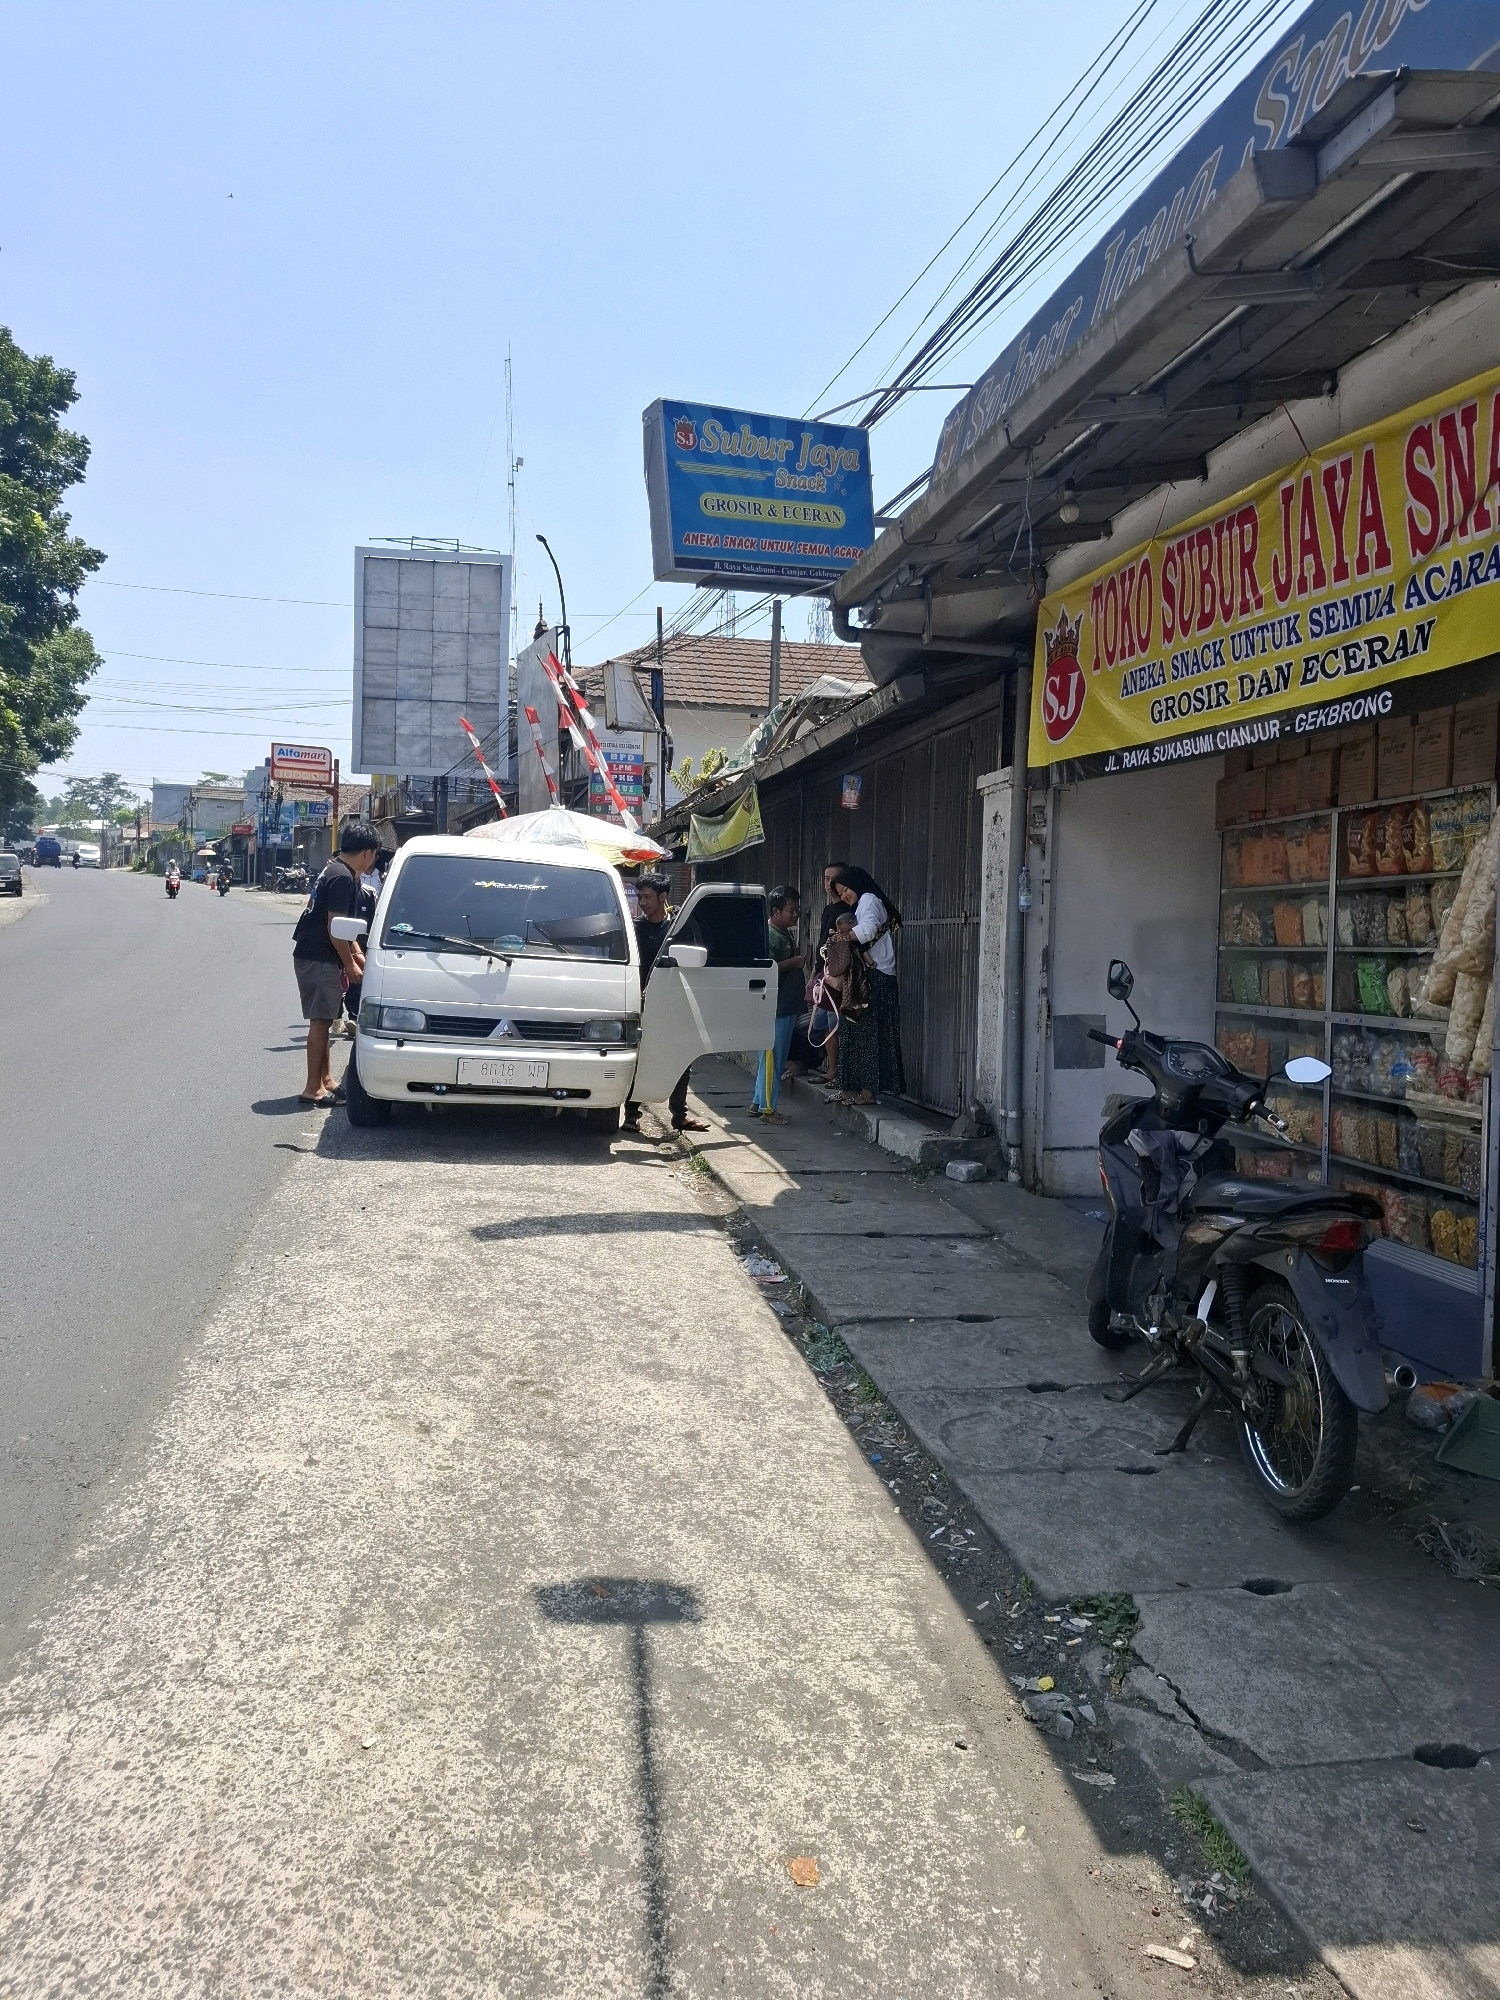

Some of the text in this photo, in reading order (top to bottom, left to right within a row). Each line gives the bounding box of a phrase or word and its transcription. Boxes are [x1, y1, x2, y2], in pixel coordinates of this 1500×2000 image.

[676, 431, 694, 446] SJ
[700, 419, 860, 476] Subur Jaya
[775, 468, 827, 493] Snack
[703, 496, 842, 524] GROSIR & ECERAN
[683, 532, 720, 547] ANEKA
[723, 535, 757, 551] SNACK
[760, 539, 794, 554] UNTUK
[796, 542, 830, 558] SEMUA
[713, 561, 722, 570] Jl.
[723, 562, 741, 573] Raya
[743, 564, 776, 574] Sukabumi
[1090, 551, 1153, 676] TOKO
[1161, 502, 1264, 650] SUBUR
[1272, 442, 1392, 603] JAYA
[1120, 543, 1500, 699] ANEKA SNACK UNTUK SEMUA ACARA
[1150, 617, 1437, 726] GROSIR DAN ECERAN
[1043, 670, 1080, 727] SJ
[1104, 753, 1120, 772] JL.
[1122, 747, 1150, 769] RAYA
[1151, 733, 1215, 764] SUKABUMI
[1216, 718, 1280, 756] CIANJUR
[1294, 690, 1393, 734] GEKBRONG
[277, 747, 328, 760] Alfamart
[610, 753, 635, 761] BPD
[462, 1062, 468, 1074] F
[528, 1065, 545, 1077] WP
